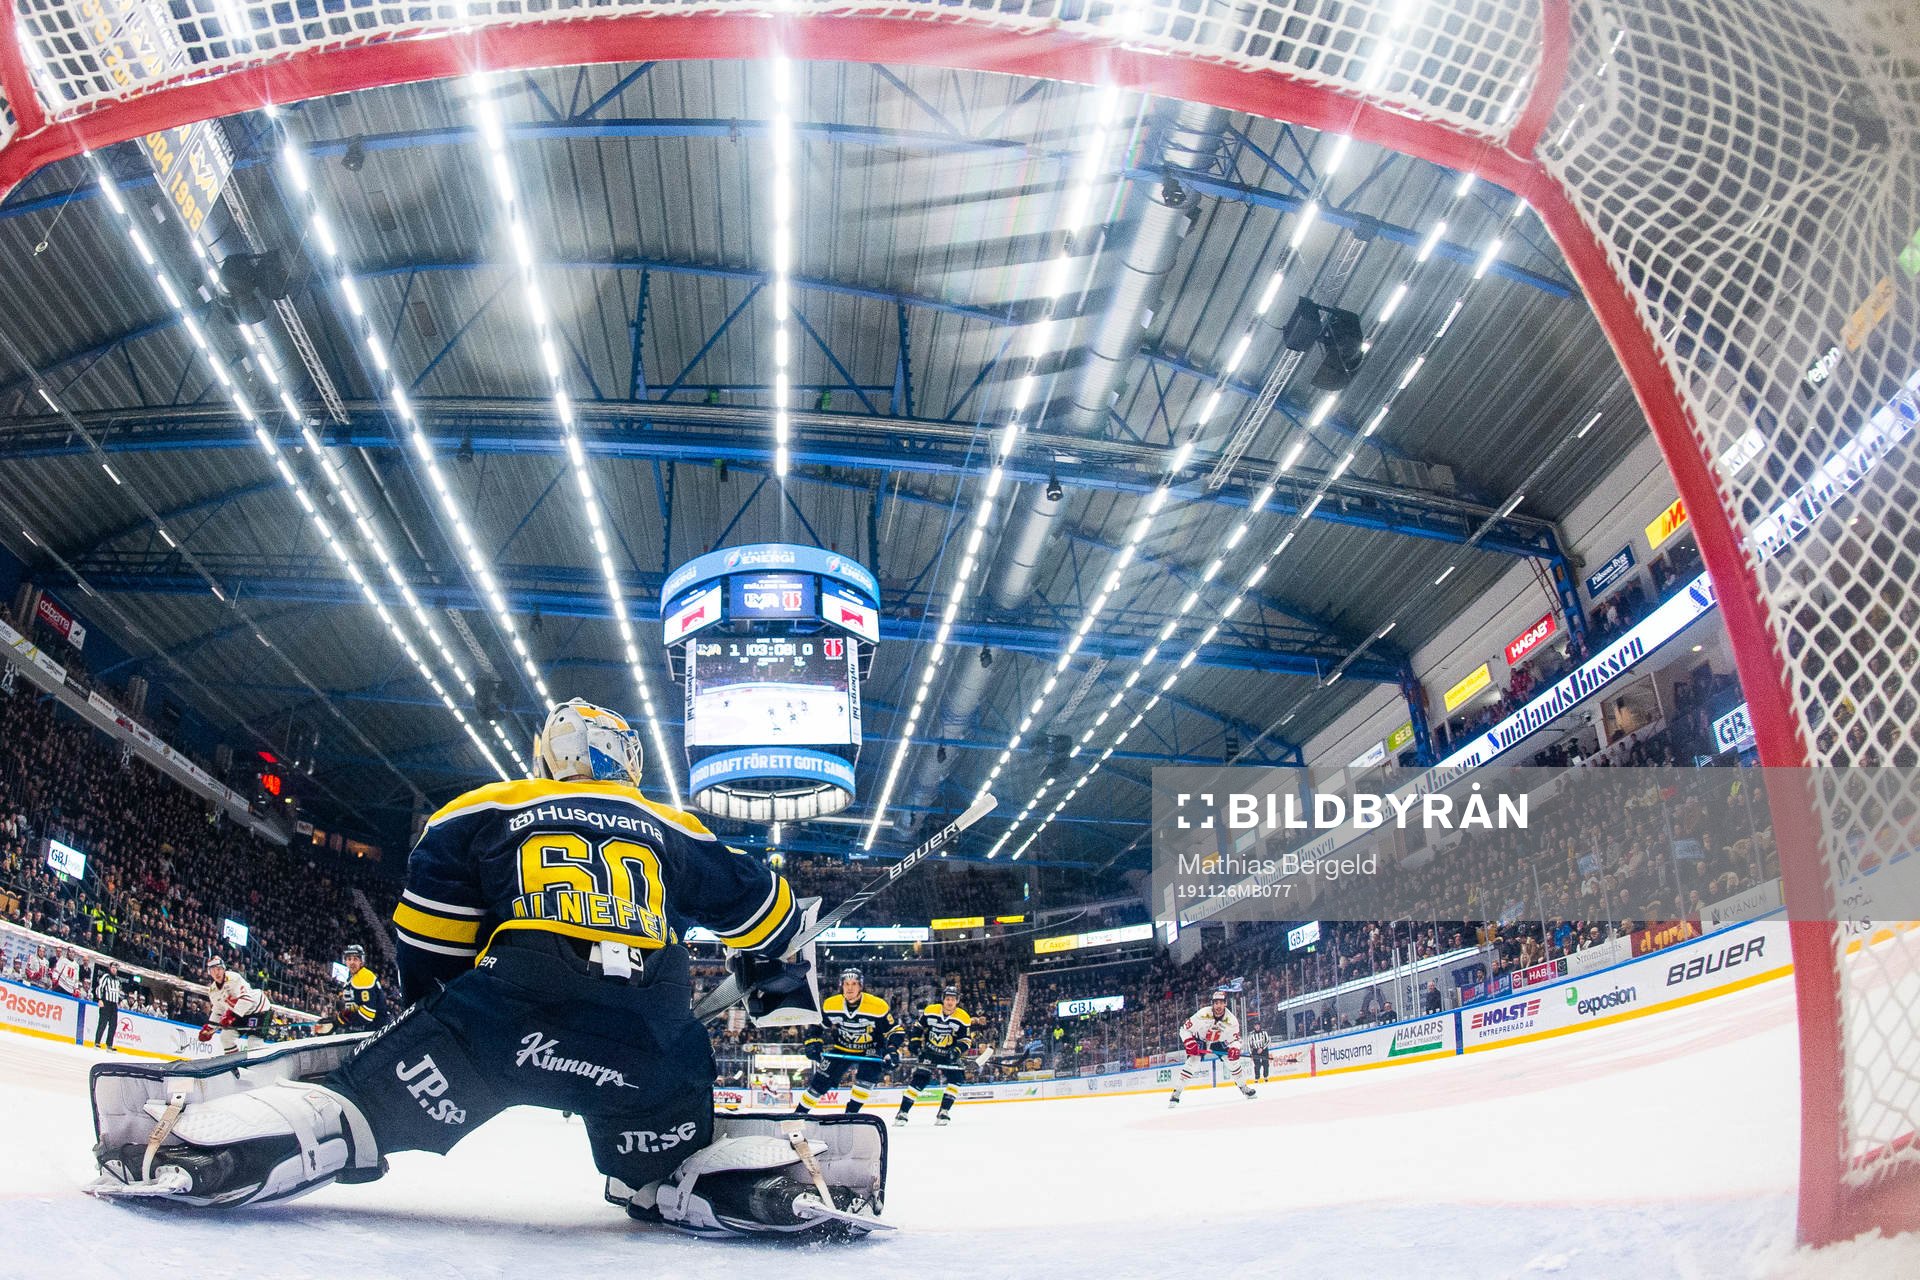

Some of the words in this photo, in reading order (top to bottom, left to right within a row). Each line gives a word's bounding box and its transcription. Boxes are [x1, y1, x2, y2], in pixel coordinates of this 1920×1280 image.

[170, 170, 204, 233] 1995
[1511, 621, 1547, 658] HAGAB
[1394, 726, 1412, 746] SEB
[709, 756, 742, 778] KRAFT
[743, 753, 768, 770] FÖR
[770, 755, 792, 769] ETT
[794, 756, 823, 772] GOTT
[537, 805, 663, 844] Husqvarna
[889, 822, 958, 881] BAUER
[516, 831, 667, 927] 60
[1666, 935, 1766, 987] BAUER
[0, 985, 64, 1021] Passera
[360, 990, 370, 1002] 8
[1577, 985, 1637, 1016] exposion
[1396, 1020, 1444, 1041] HAKARPS
[1479, 1022, 1524, 1038] ENTREPRENAD
[1523, 1019, 1534, 1029] AB
[1482, 1002, 1528, 1027] HOLST
[516, 1032, 639, 1088] Kinnarps
[1329, 1043, 1373, 1062] Husqvarna
[396, 1054, 467, 1125] JP.se
[616, 1121, 696, 1155] JP.se
